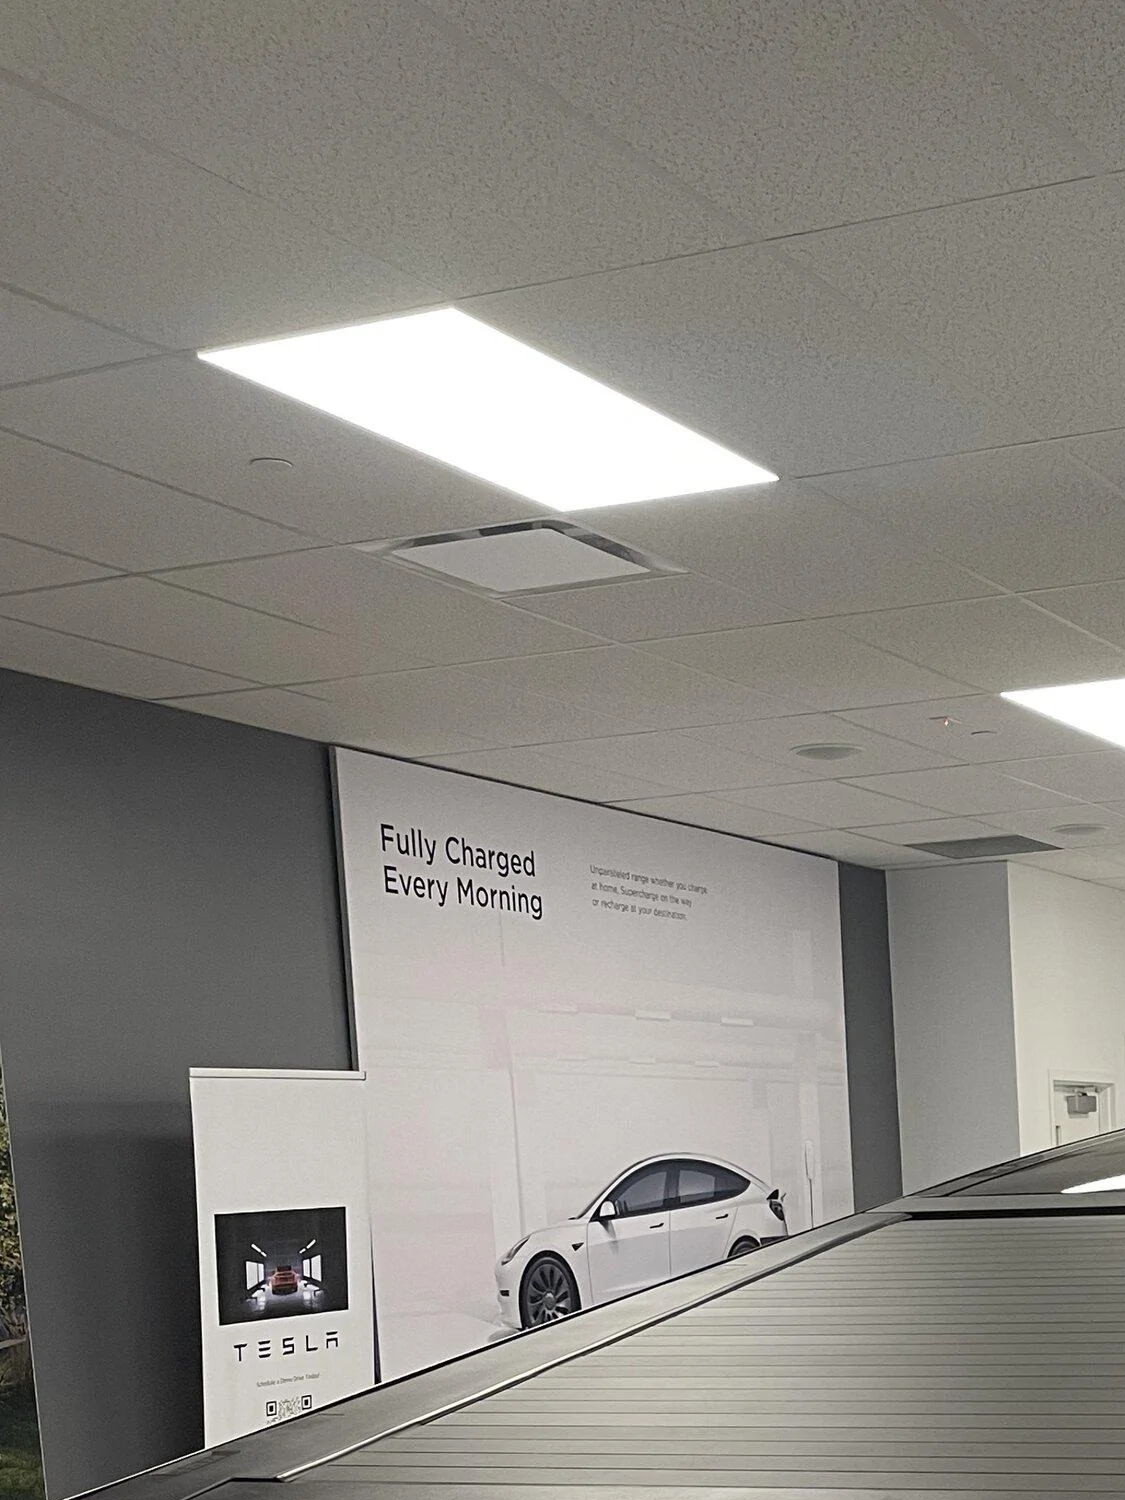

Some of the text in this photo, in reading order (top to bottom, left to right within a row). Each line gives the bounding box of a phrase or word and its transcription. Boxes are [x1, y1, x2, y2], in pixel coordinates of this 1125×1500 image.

[380, 823, 536, 878] Fully Charged
[383, 865, 543, 920] Every Morning
[233, 1331, 338, 1361] TESLA
